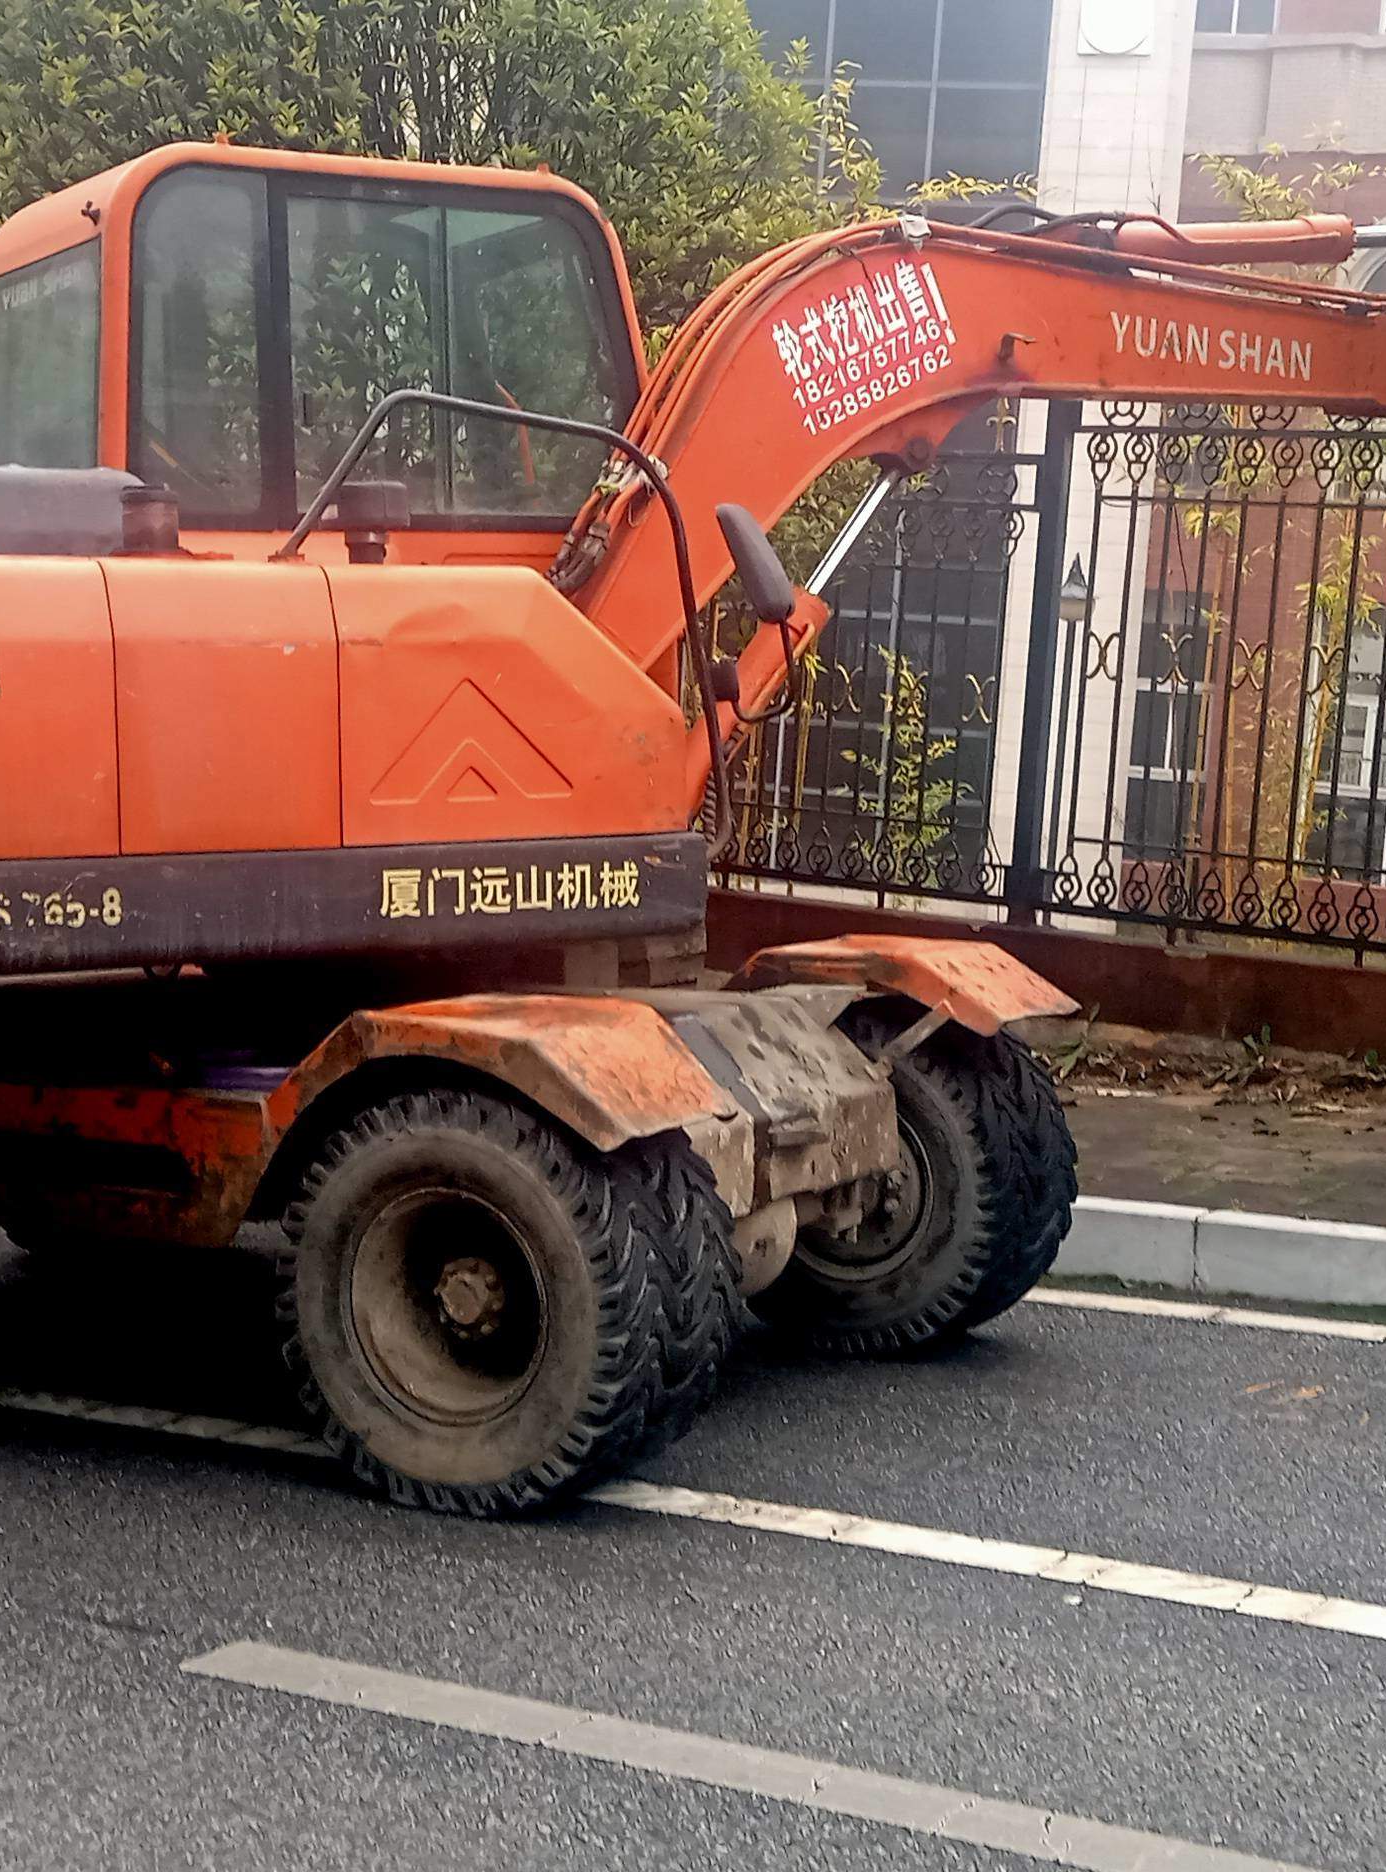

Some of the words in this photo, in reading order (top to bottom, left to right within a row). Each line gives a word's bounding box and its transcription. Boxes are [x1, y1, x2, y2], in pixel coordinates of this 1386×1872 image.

[792, 317, 941, 409] 18216757746
[1110, 311, 1209, 366] YUAN
[1218, 329, 1311, 381] SHAN
[802, 344, 952, 436] 15285826762
[380, 860, 640, 919] 厦门远山机械
